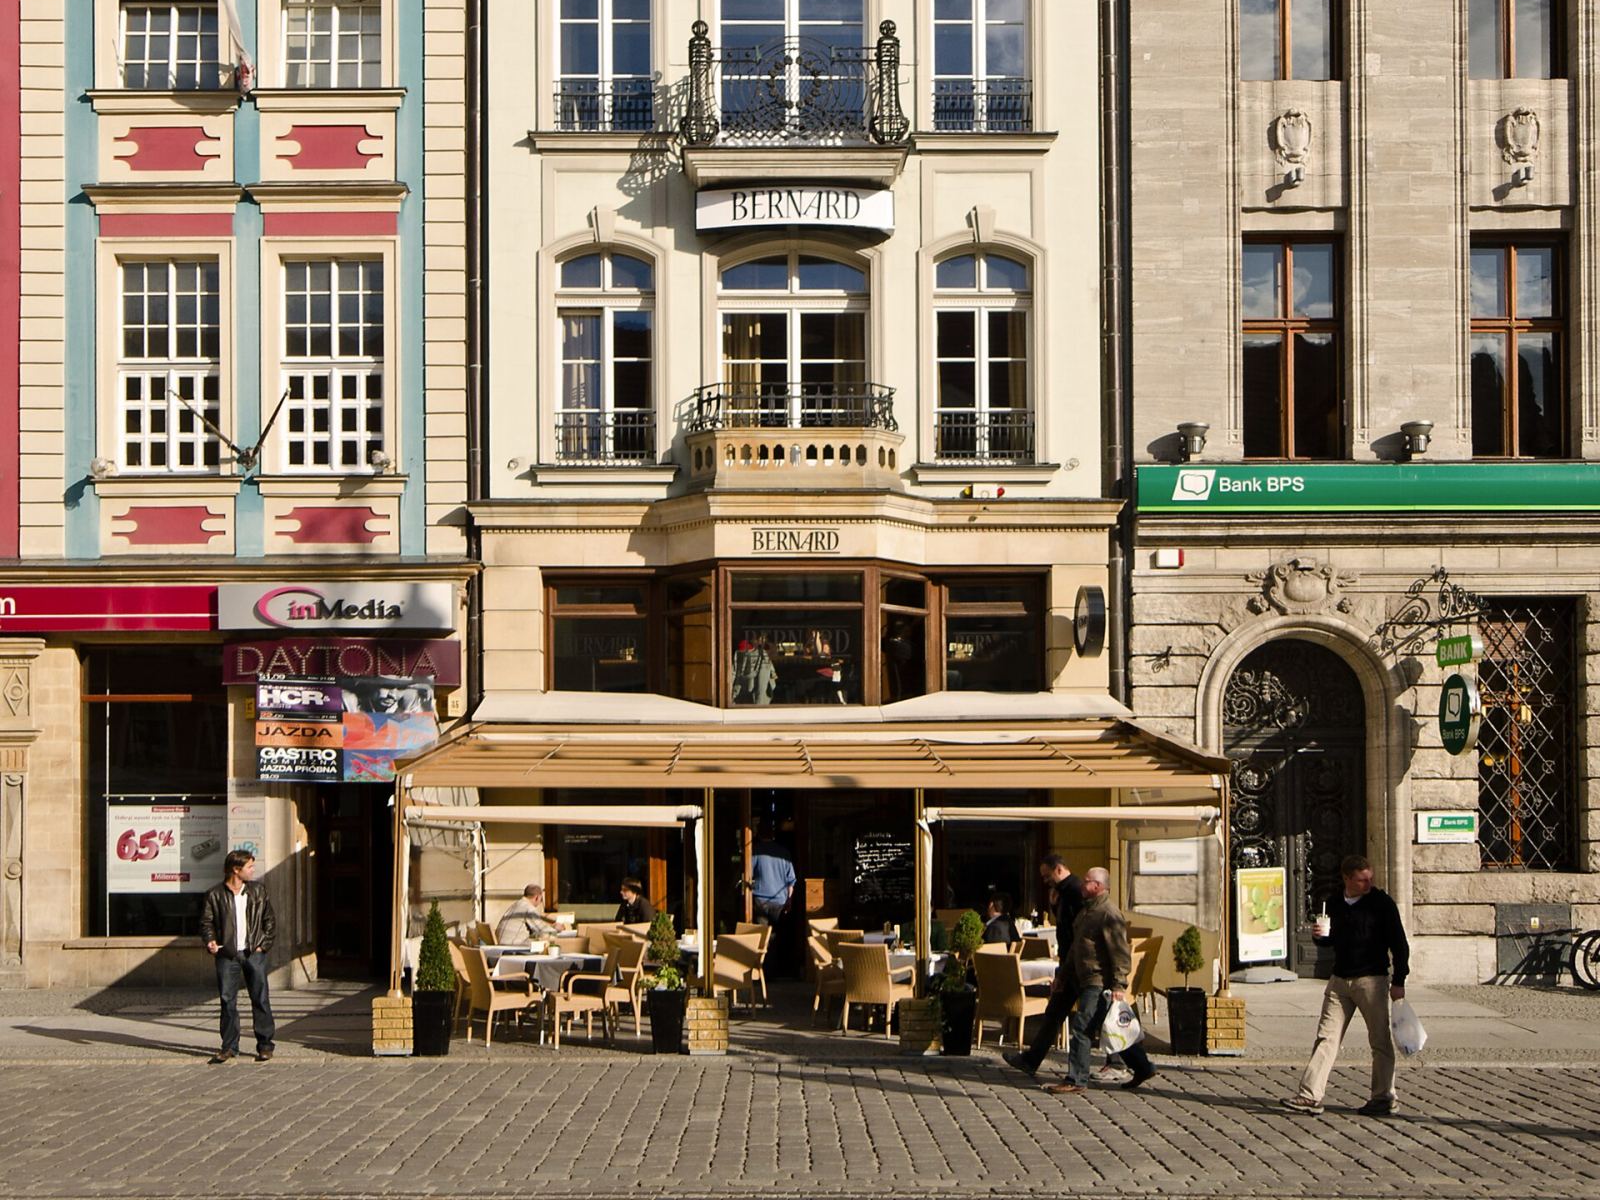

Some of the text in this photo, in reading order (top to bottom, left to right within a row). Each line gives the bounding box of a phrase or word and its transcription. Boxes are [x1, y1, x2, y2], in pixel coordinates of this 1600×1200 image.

[731, 189, 861, 221] BERNARD
[1219, 477, 1305, 492] Bank BPS
[753, 531, 840, 552] BERNARD
[1439, 642, 1468, 662] BANK
[236, 645, 440, 677] DAYTONA
[258, 727, 332, 738] JAZDA
[1442, 728, 1465, 739] Bank BPS
[260, 748, 337, 760] GASTRO
[295, 764, 337, 774] PRÓBNA
